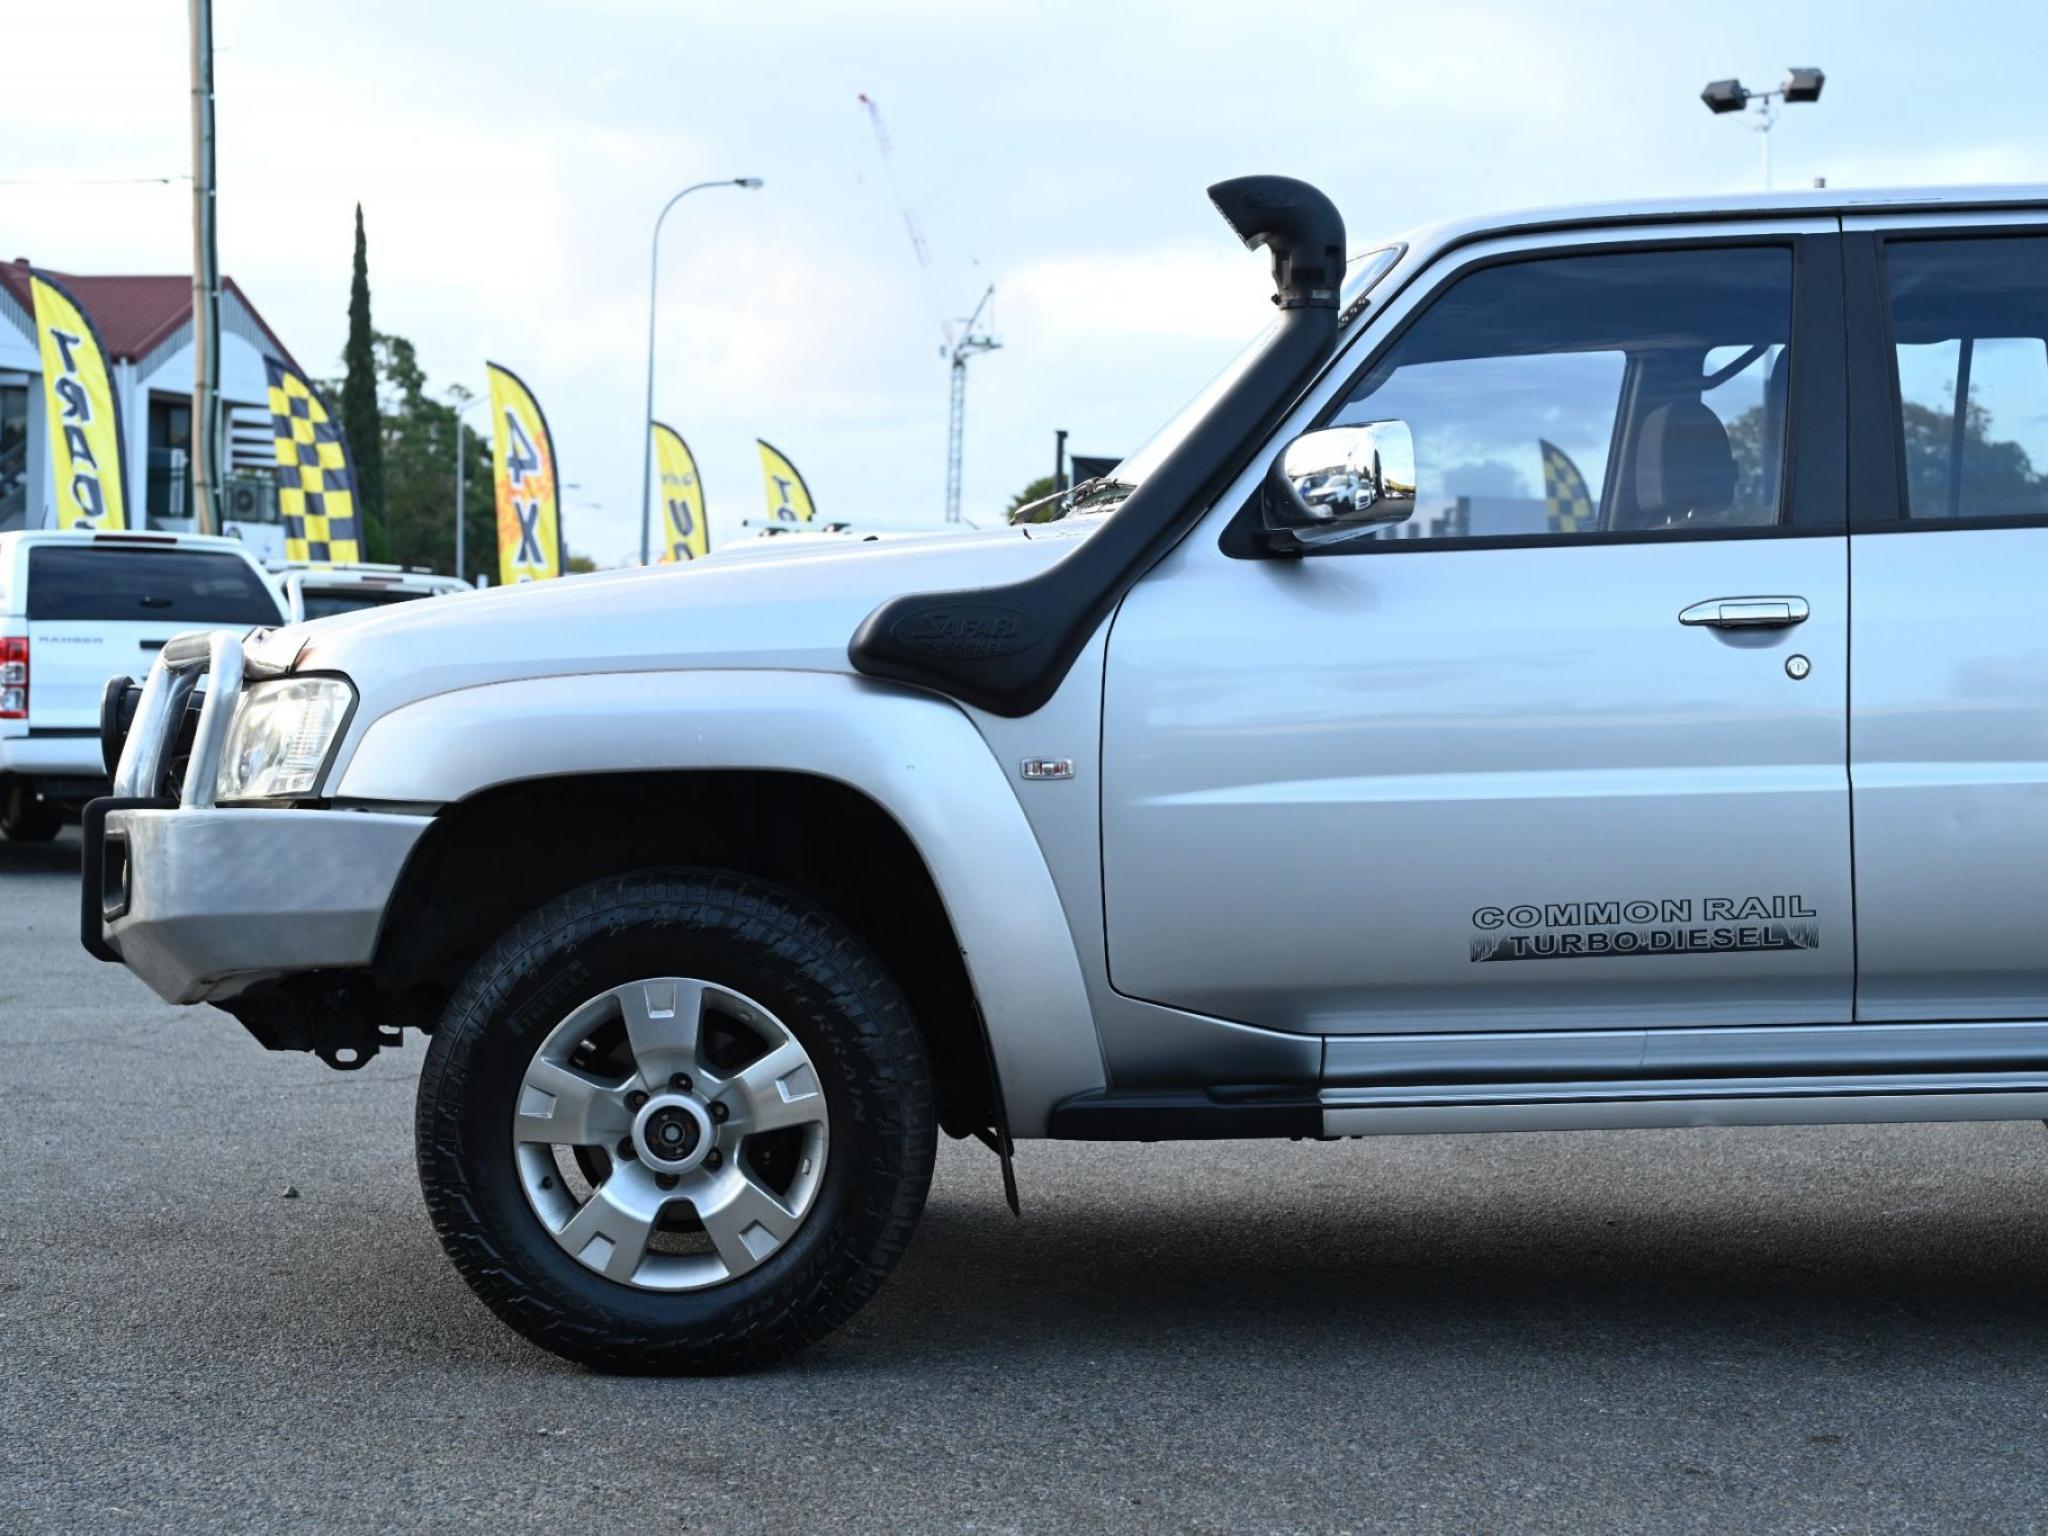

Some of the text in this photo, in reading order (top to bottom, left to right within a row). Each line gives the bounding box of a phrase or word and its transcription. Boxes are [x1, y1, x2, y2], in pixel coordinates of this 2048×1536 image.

[1472, 895, 1817, 930] COMMON RAIL
[1508, 925, 1784, 955] TURBO DIESEL
